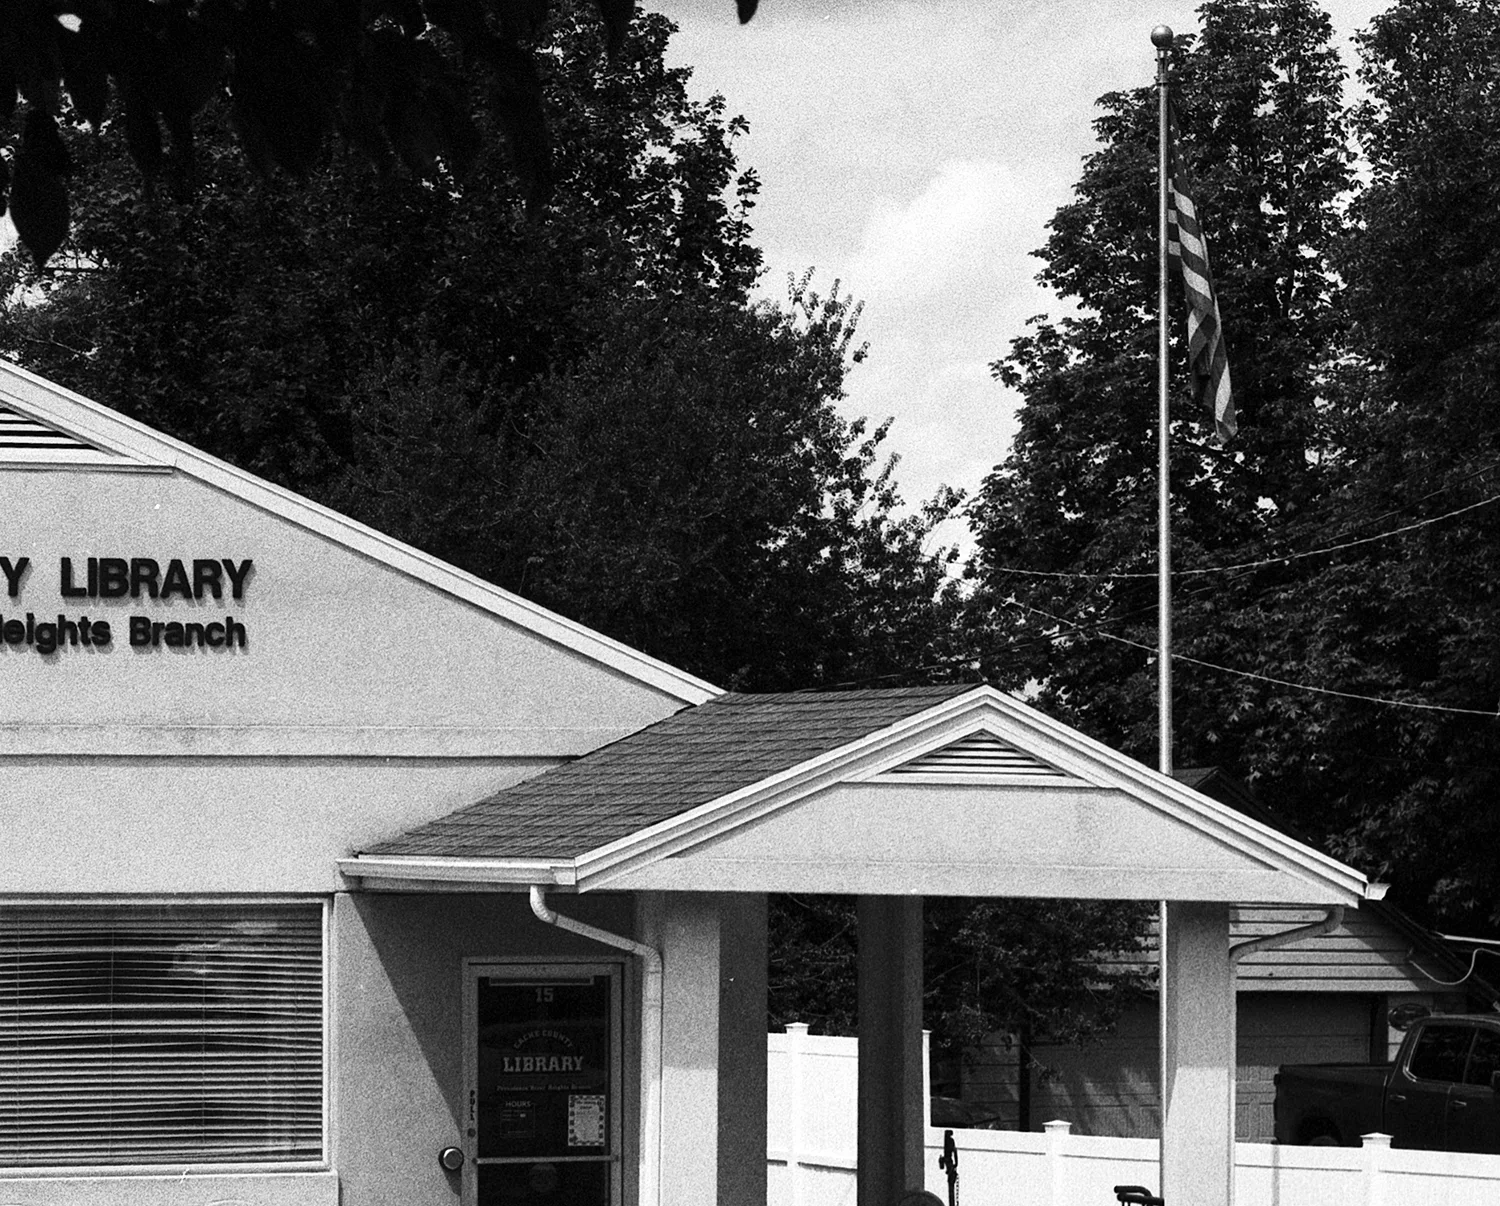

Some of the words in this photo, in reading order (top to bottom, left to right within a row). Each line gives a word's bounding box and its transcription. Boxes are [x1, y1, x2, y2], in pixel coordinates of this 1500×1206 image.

[60, 557, 252, 600] LIBRARY
[129, 615, 246, 648] Branch
[535, 987, 554, 1003] 15
[513, 1029, 541, 1050] CACHE
[542, 1029, 574, 1049] COUNTY
[502, 1055, 584, 1073] LIBRARY
[505, 1100, 531, 1108] HOURS
